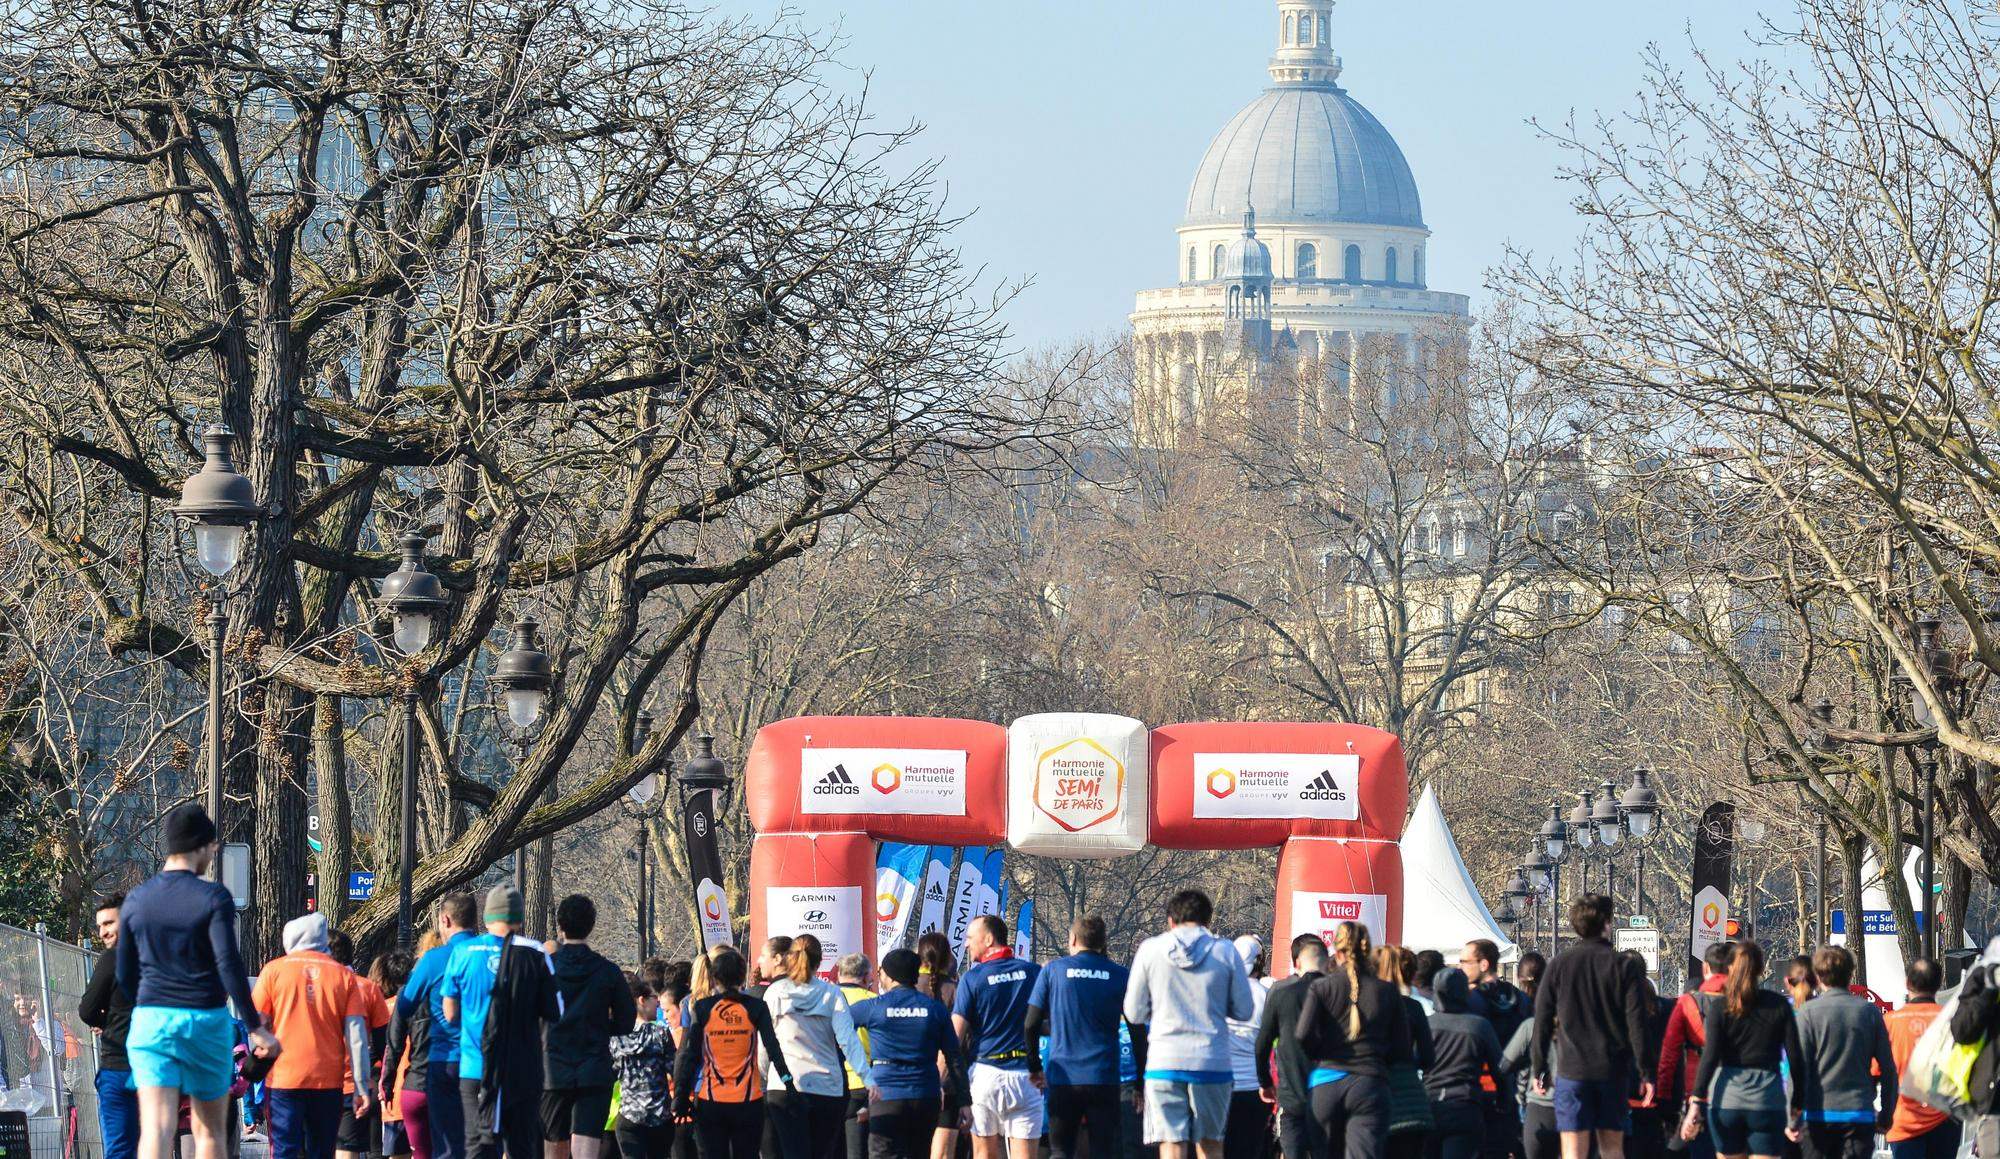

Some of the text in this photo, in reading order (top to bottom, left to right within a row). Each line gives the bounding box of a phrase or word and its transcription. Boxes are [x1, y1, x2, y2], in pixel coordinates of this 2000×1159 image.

[1053, 759, 1105, 768] Harmonie
[905, 766, 955, 775] Harmonie
[1052, 768, 1105, 777] mutuelle
[1239, 769, 1289, 778] Harmonie
[905, 775, 955, 783] mutuelle
[1239, 778, 1289, 786] mutuelle
[813, 784, 860, 795] adidas
[937, 789, 954, 797] vyv
[1272, 792, 1288, 800] vyv
[1299, 789, 1346, 801] adidas
[1053, 799, 1069, 810] DE
[349, 887, 373, 896] uai d
[791, 894, 836, 902] GARMIN
[925, 893, 946, 903] adidas
[1323, 903, 1356, 917] Vittel
[951, 880, 975, 957] ARMIN
[1863, 914, 1893, 922] ont Sul
[987, 969, 1027, 985] ECOLAB
[1066, 968, 1110, 980] ECOLAB
[886, 1007, 928, 1018] ECOLAB
